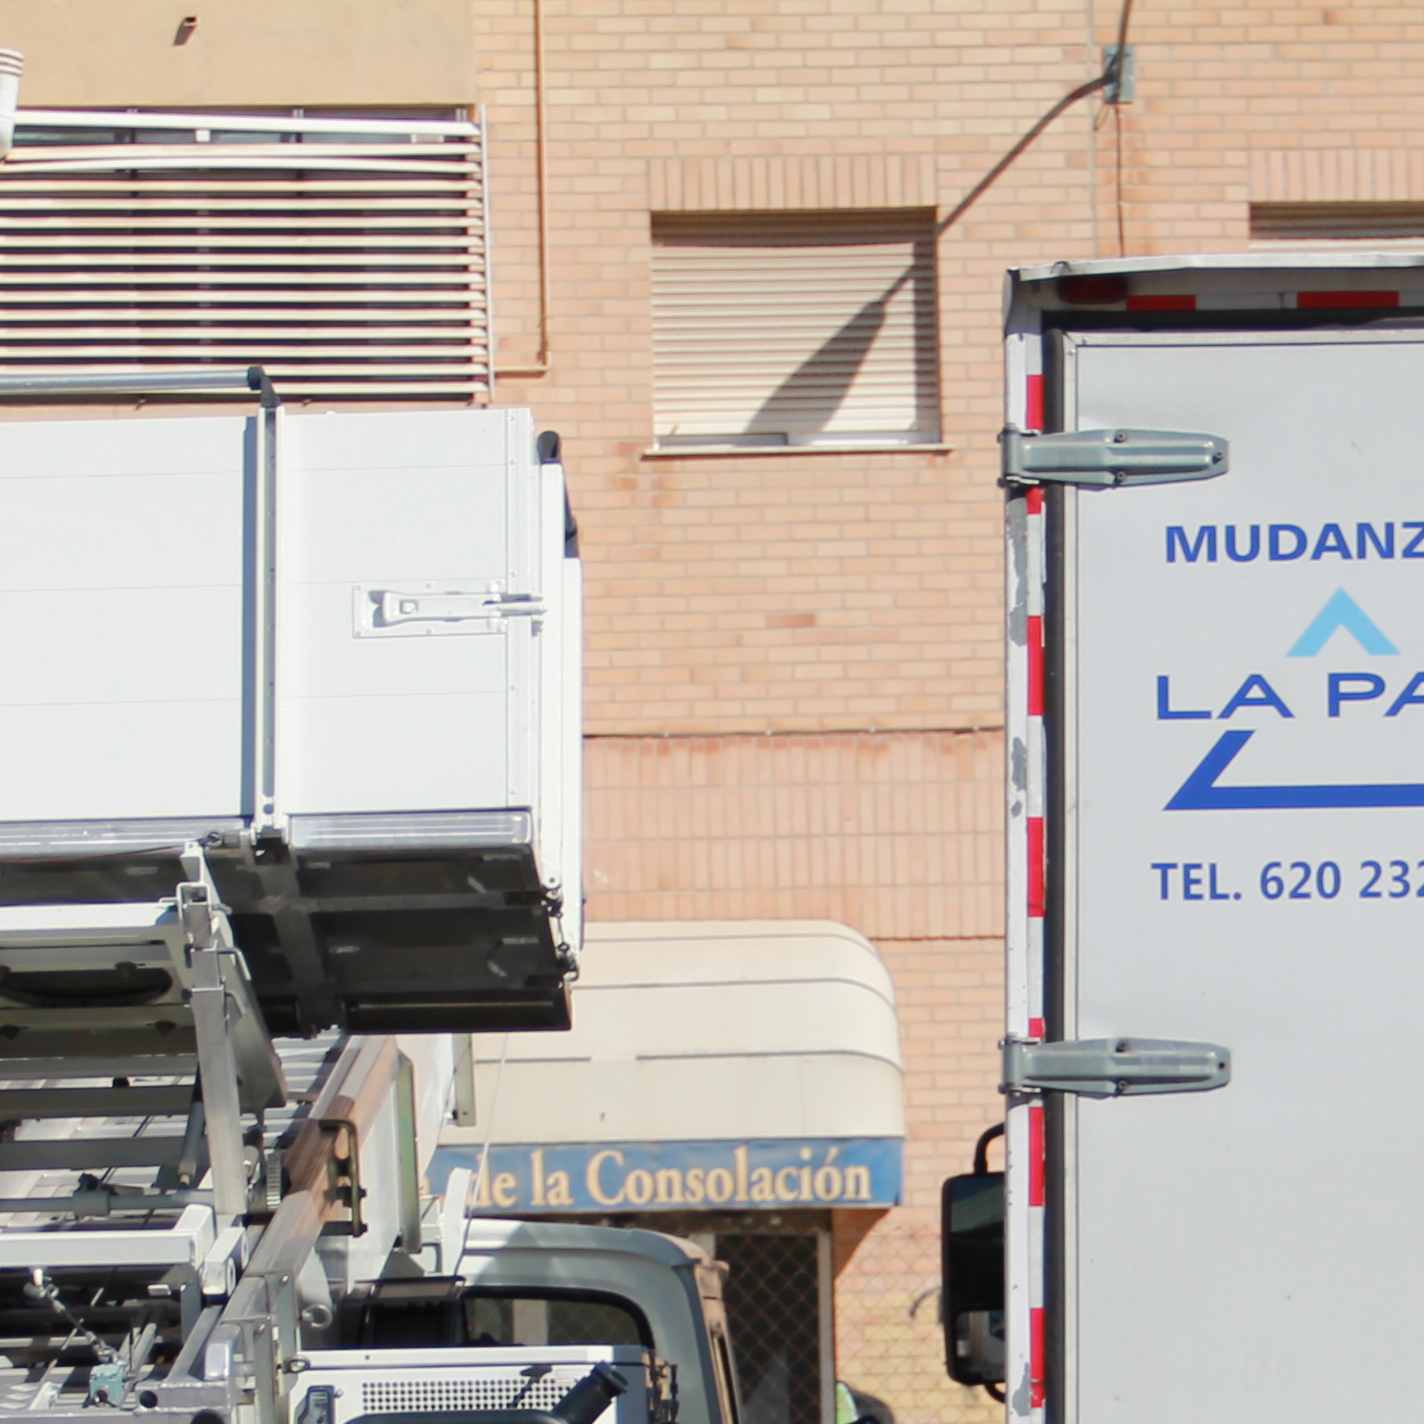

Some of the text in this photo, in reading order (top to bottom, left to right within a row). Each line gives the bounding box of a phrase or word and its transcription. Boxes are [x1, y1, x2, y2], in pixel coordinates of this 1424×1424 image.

[1157, 673, 1295, 720] LA
[1151, 862, 1242, 900] TEL.
[1259, 861, 1341, 899] 620
[467, 1145, 873, 1208] de la Consolación
